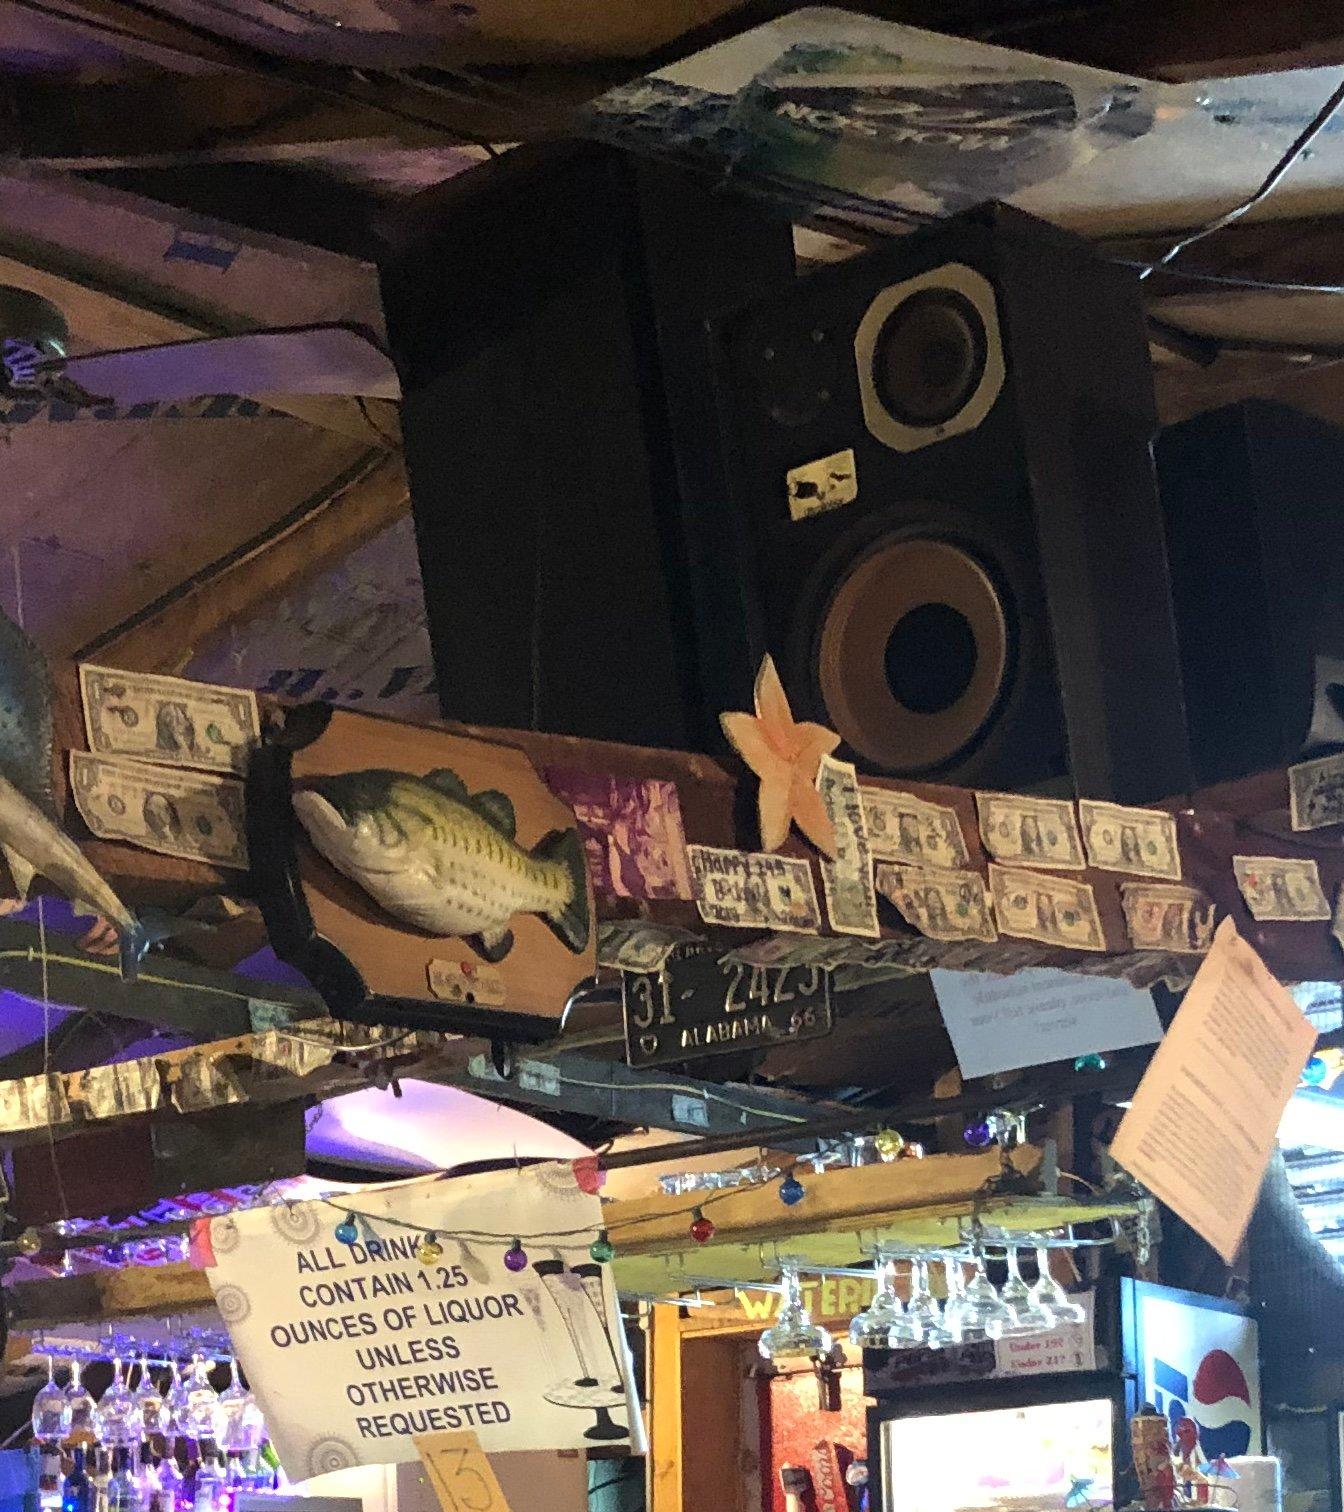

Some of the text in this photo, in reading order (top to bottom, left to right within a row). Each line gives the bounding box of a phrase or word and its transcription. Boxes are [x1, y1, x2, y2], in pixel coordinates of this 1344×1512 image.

[681, 1014, 773, 1048] ALABAMA
[296, 1234, 428, 1274] ALL DRINK
[299, 1264, 469, 1309] CONTAIN 1.25
[269, 1293, 525, 1349] OUNCES OF LIQUOR
[356, 1335, 461, 1371] UNLESS
[346, 1367, 499, 1407] OTHERWISE
[357, 1400, 512, 1439] REQUESTED
